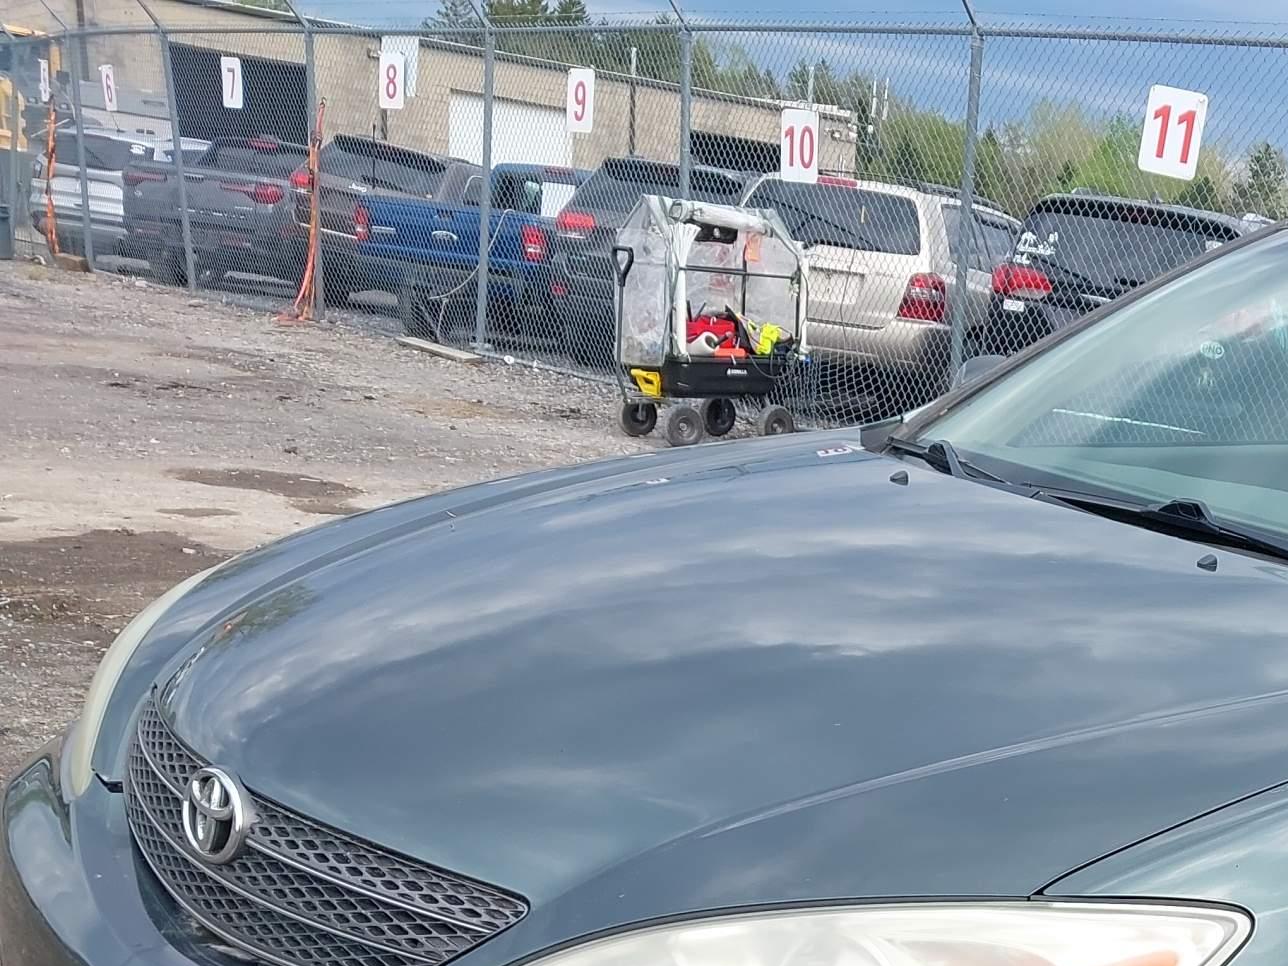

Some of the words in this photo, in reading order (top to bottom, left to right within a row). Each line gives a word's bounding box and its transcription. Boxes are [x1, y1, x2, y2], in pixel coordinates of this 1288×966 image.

[105, 73, 113, 103] 6
[226, 67, 236, 99] 7
[386, 64, 397, 99] 8
[574, 80, 586, 122] 9
[784, 125, 815, 169] 10
[1153, 104, 1197, 164] 11
